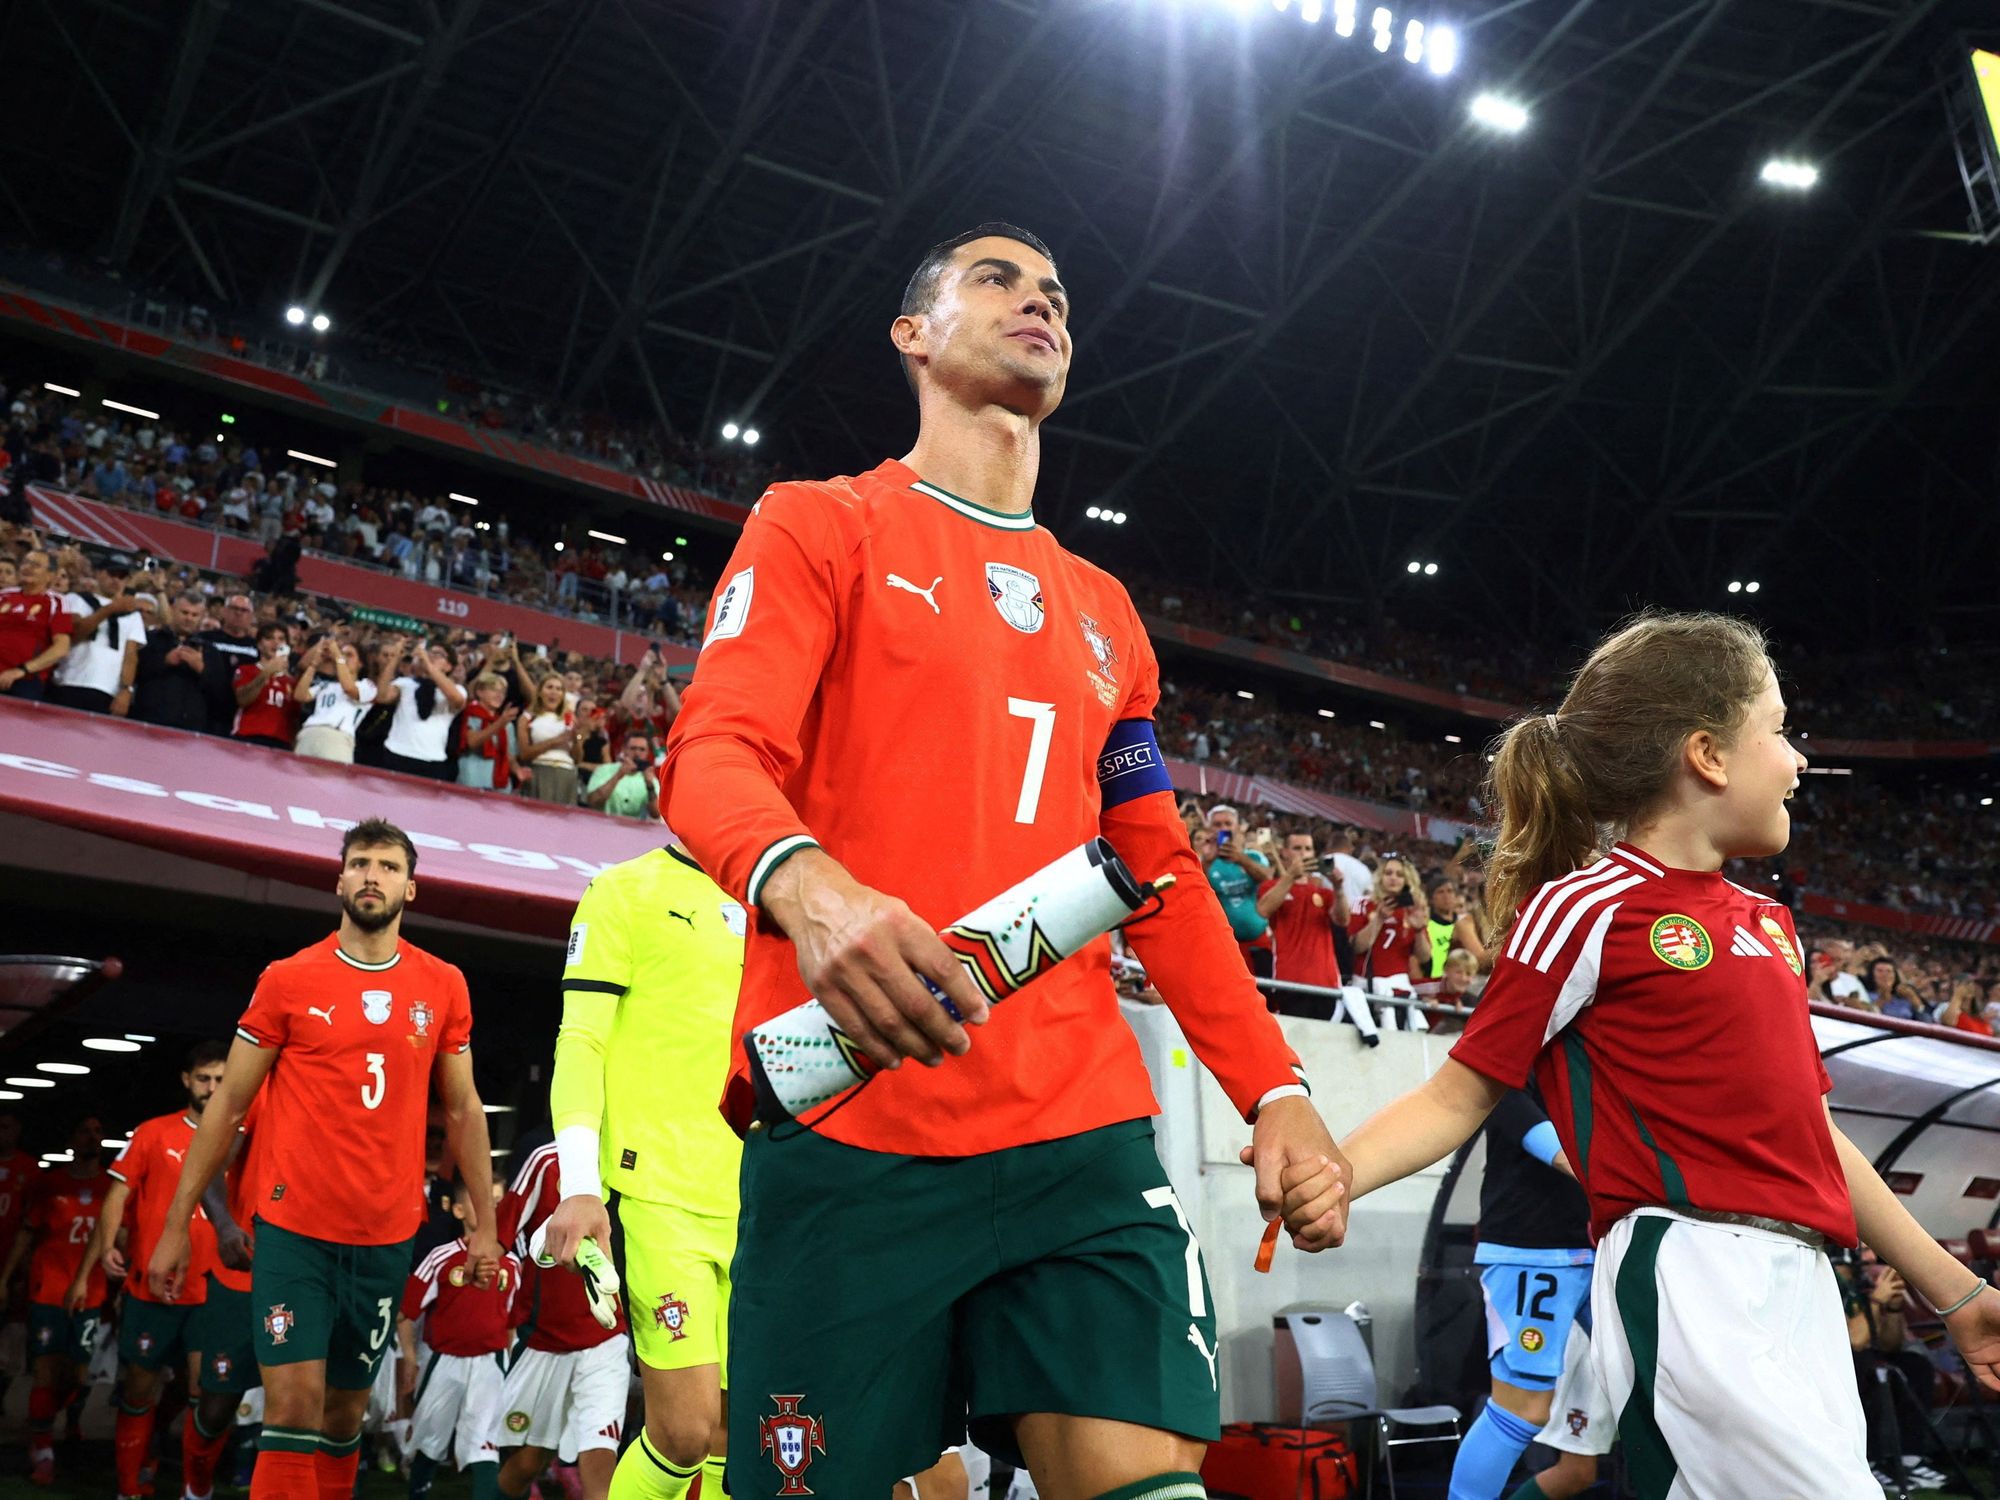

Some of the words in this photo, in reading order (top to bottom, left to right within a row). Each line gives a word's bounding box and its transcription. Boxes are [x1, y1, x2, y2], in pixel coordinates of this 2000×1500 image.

[437, 598, 469, 618] 119
[1007, 696, 1057, 824] 7
[1382, 929, 1396, 950] 7
[361, 1053, 386, 1109] 3
[1142, 1186, 1206, 1317] 7
[1516, 1270, 1558, 1321] 12
[371, 1297, 393, 1350] 3
